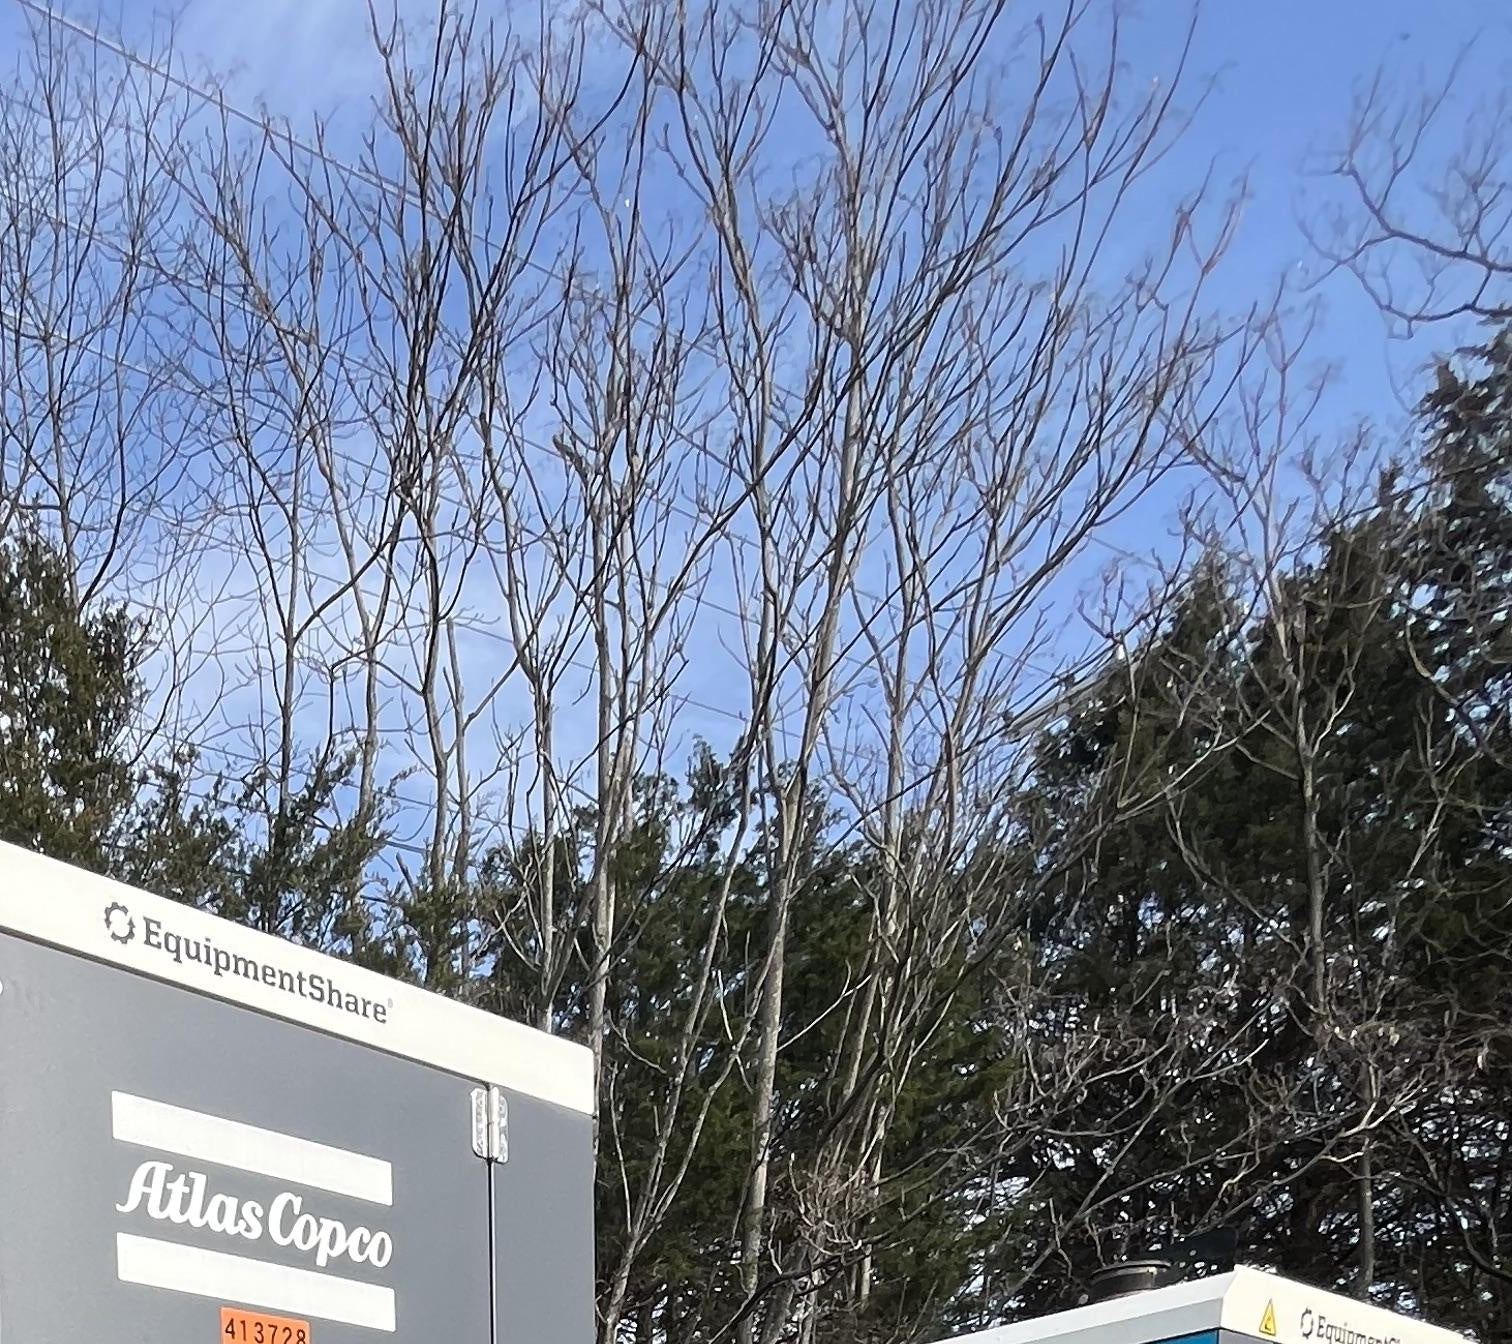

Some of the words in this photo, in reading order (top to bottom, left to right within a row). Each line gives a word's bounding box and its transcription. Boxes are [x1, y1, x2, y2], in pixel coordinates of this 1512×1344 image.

[142, 915, 388, 1025] EquipmentShare
[115, 1160, 264, 1240] Atlas
[268, 1191, 393, 1268] Copco
